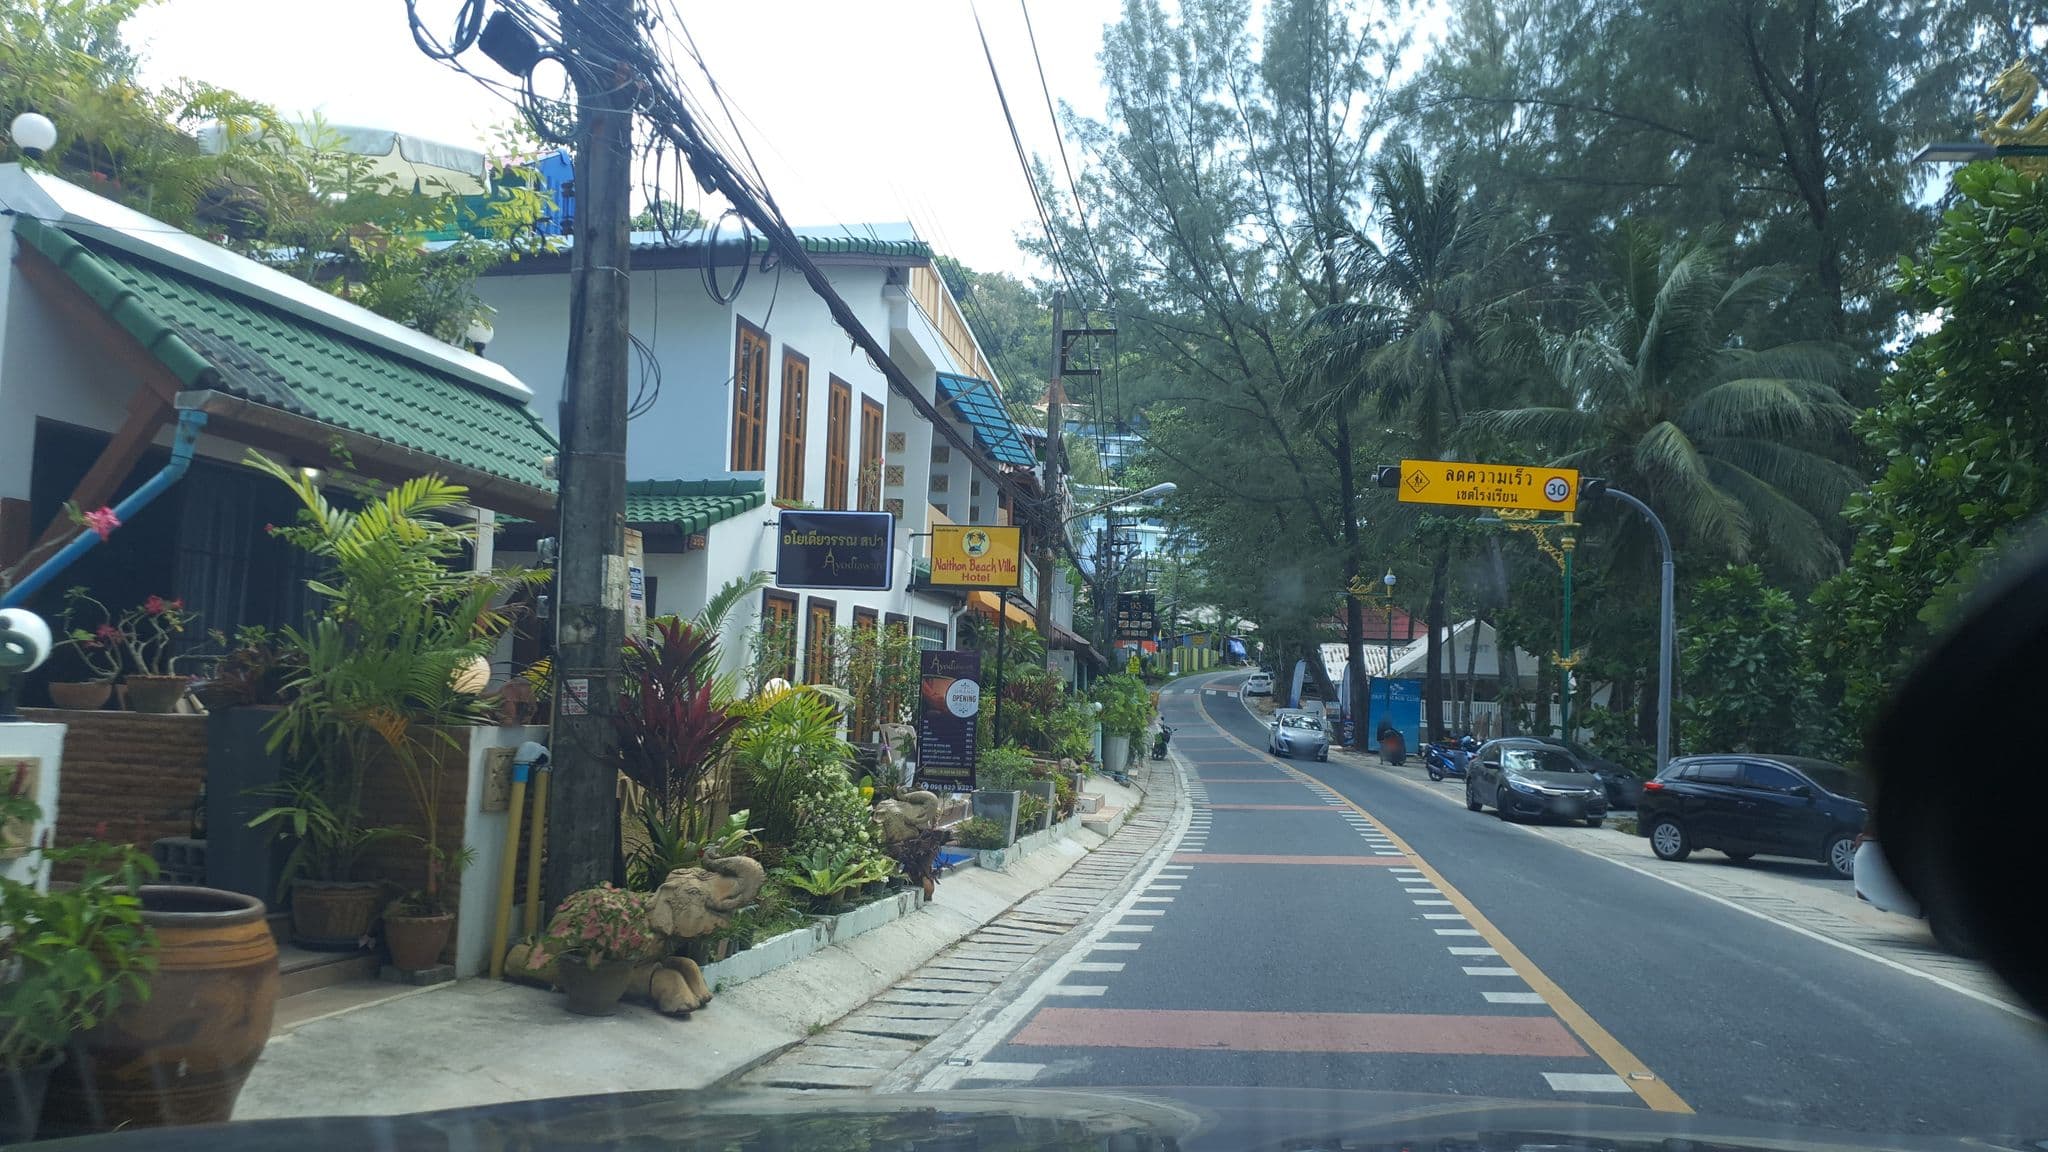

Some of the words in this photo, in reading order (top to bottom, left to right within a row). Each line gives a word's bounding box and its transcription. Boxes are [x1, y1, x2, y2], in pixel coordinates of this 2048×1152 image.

[1445, 468, 1533, 486] ลดความเร็ว
[1456, 486, 1518, 503] เขตโรงเรียน
[1547, 483, 1567, 497] 30
[784, 530, 857, 546] อโยเดียวรรณ
[860, 534, 885, 547] สปา
[934, 557, 967, 572] Naithon
[969, 558, 997, 573] Beach
[998, 559, 1016, 573] Villa
[962, 573, 990, 582] Hotel
[953, 694, 977, 703] OPENING
